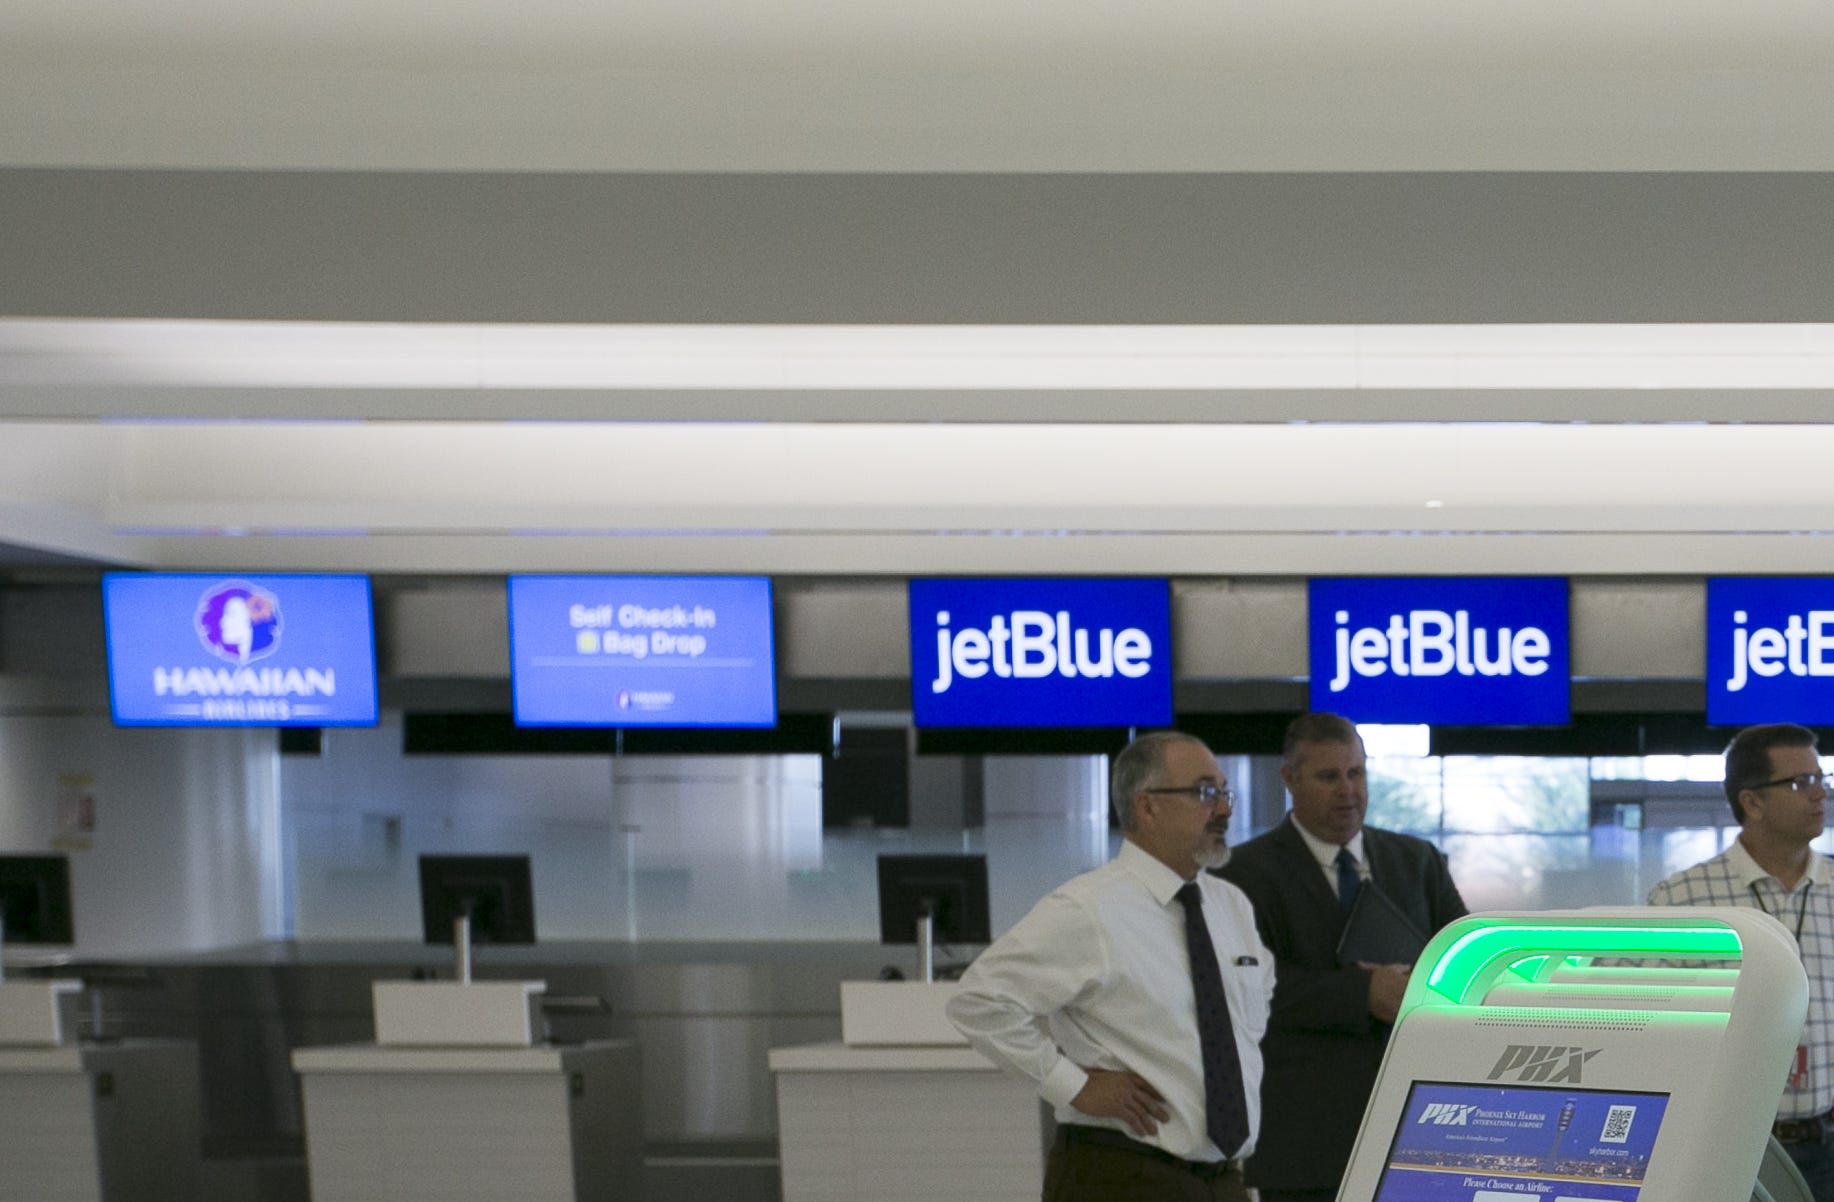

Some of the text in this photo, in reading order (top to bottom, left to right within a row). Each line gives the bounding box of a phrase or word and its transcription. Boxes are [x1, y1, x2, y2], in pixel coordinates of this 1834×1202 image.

[569, 604, 716, 628] Self Check-In
[602, 630, 706, 659] Bag Drop
[933, 611, 1151, 691] jetBlue
[1331, 611, 1549, 691] jetBlue
[153, 666, 336, 697] HAWAIIAN
[1486, 1045, 1603, 1084] PHX
[1418, 1103, 1477, 1126] PHX
[1518, 1121, 1544, 1129] AIRPORT
[1463, 1177, 1554, 1193] Please Choose an Airline:
